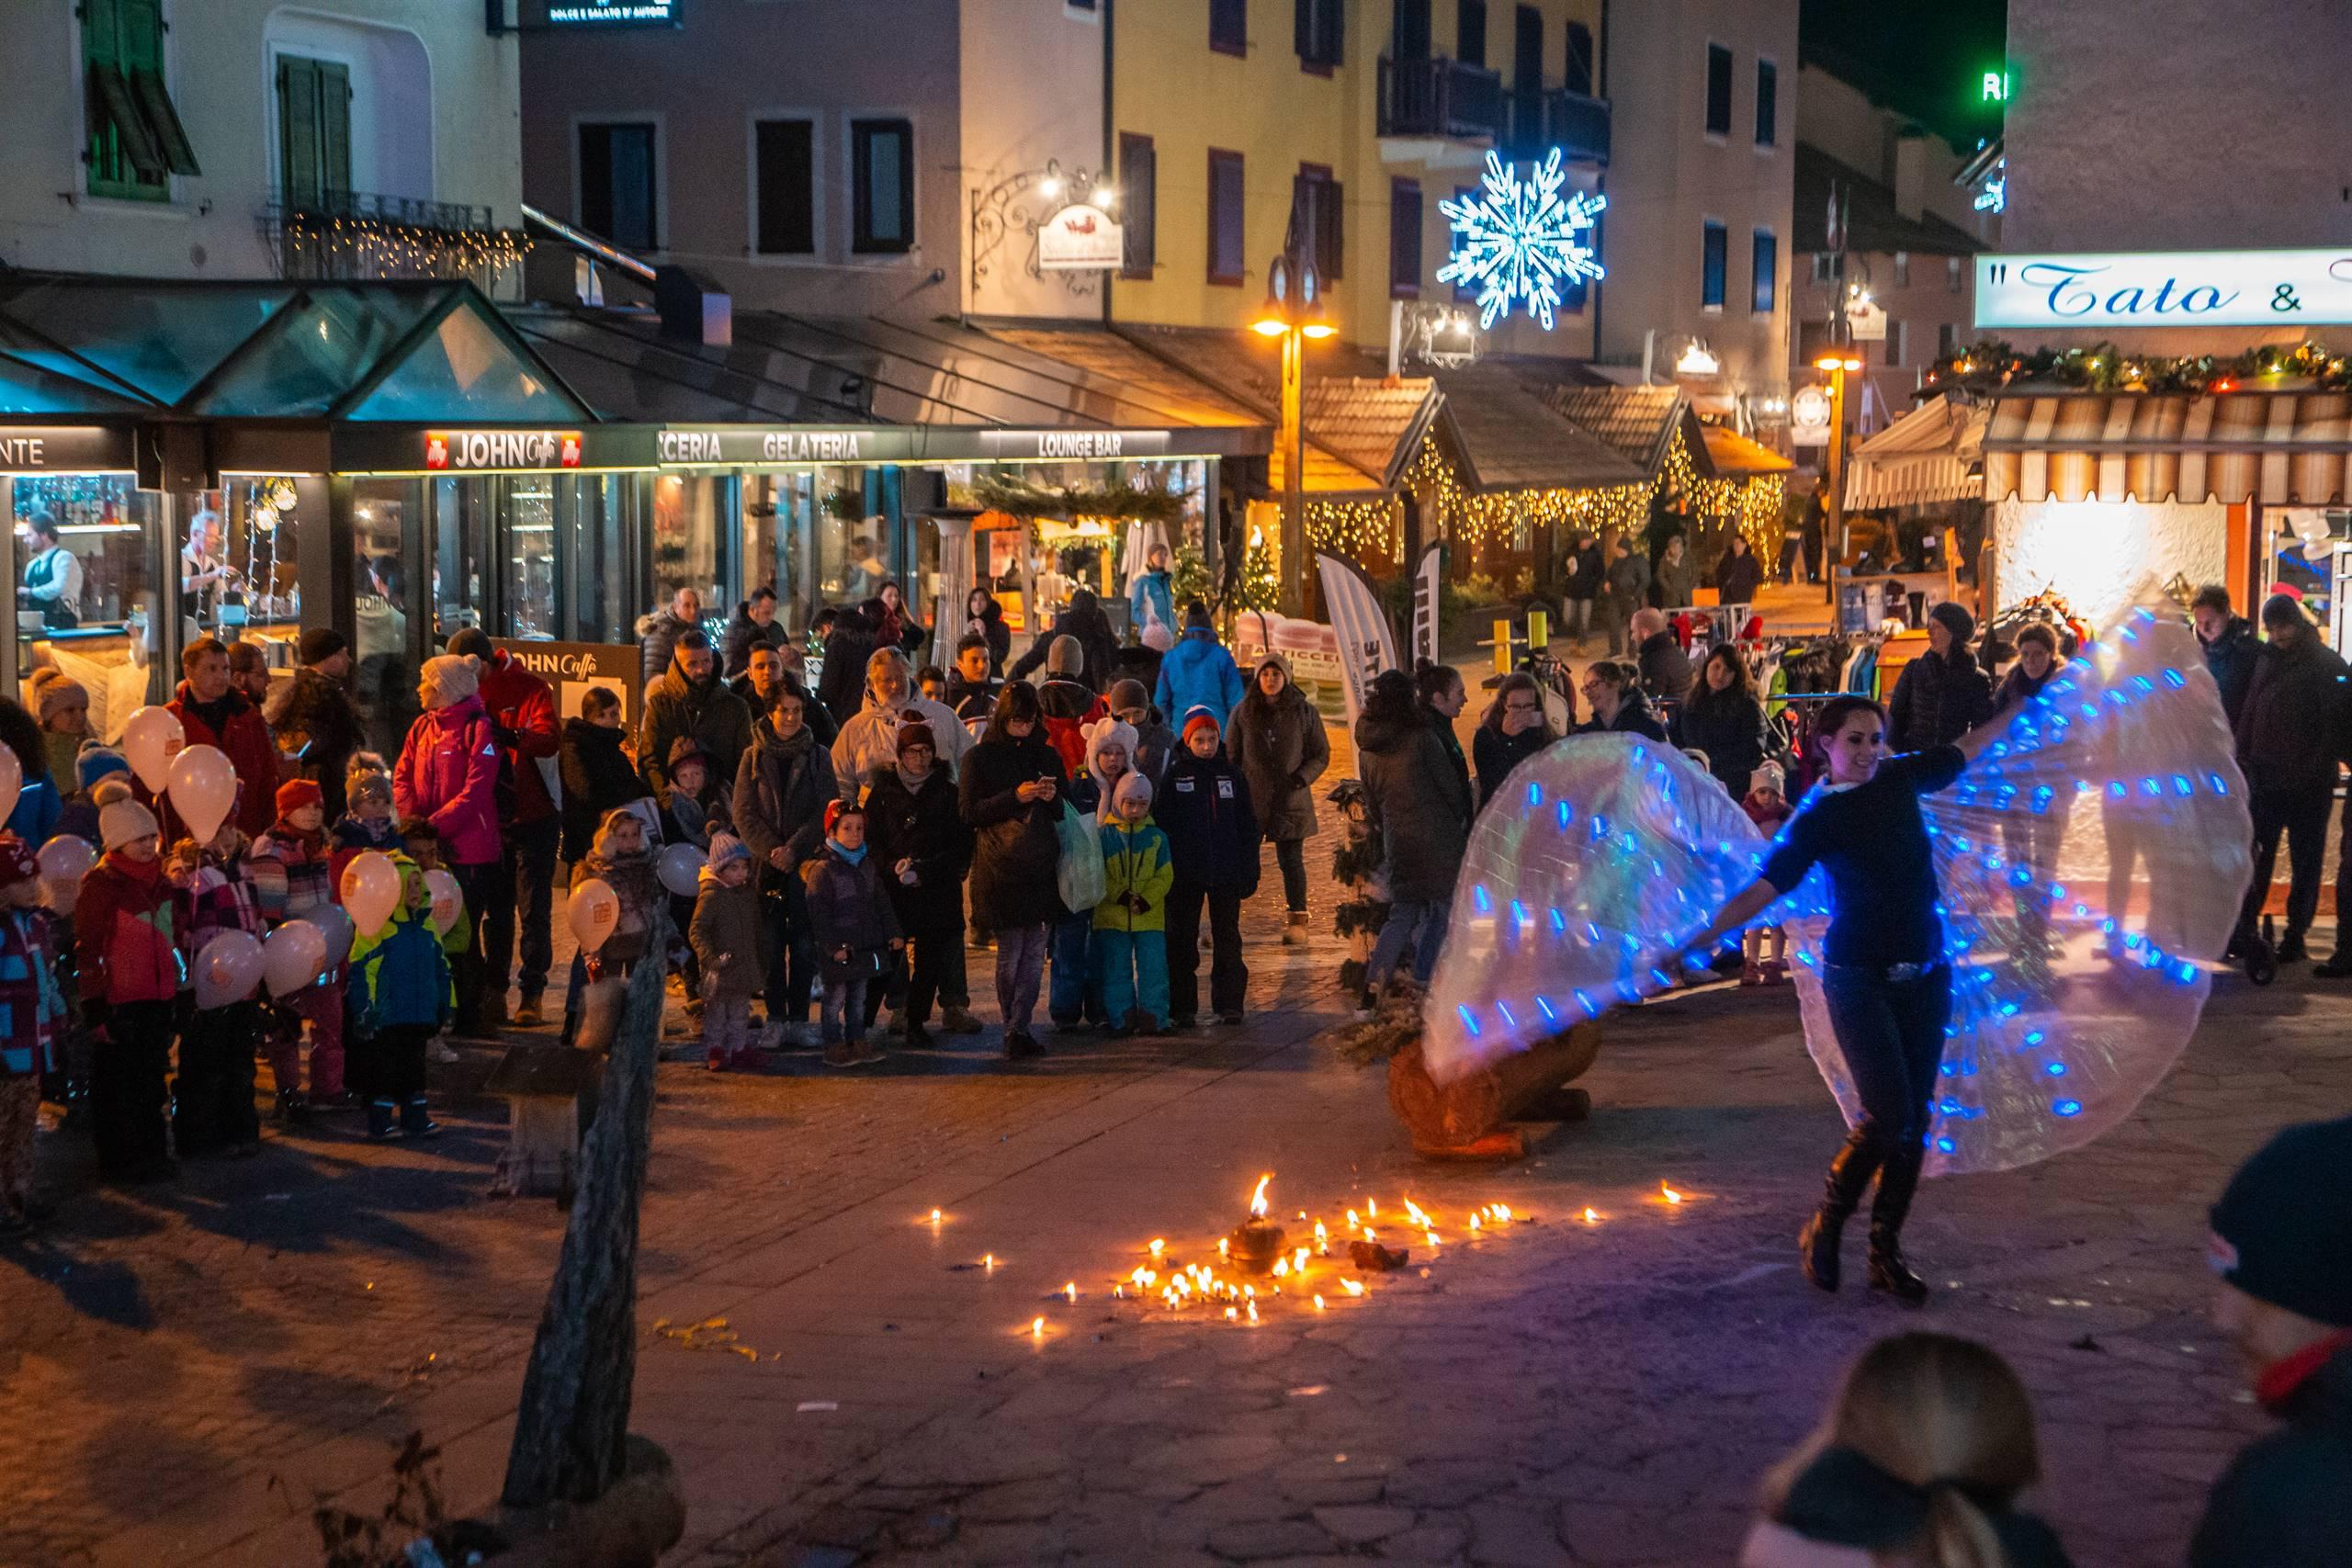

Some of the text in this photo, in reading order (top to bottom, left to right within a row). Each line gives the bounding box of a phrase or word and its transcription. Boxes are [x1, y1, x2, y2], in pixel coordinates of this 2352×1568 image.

[2270, 283, 2301, 311] &
[455, 433, 526, 468] JOHN
[658, 433, 859, 460] CERIA GELATERIA
[1038, 433, 1122, 457] LOUNGE BAR
[512, 652, 597, 681] OHN Caffè
